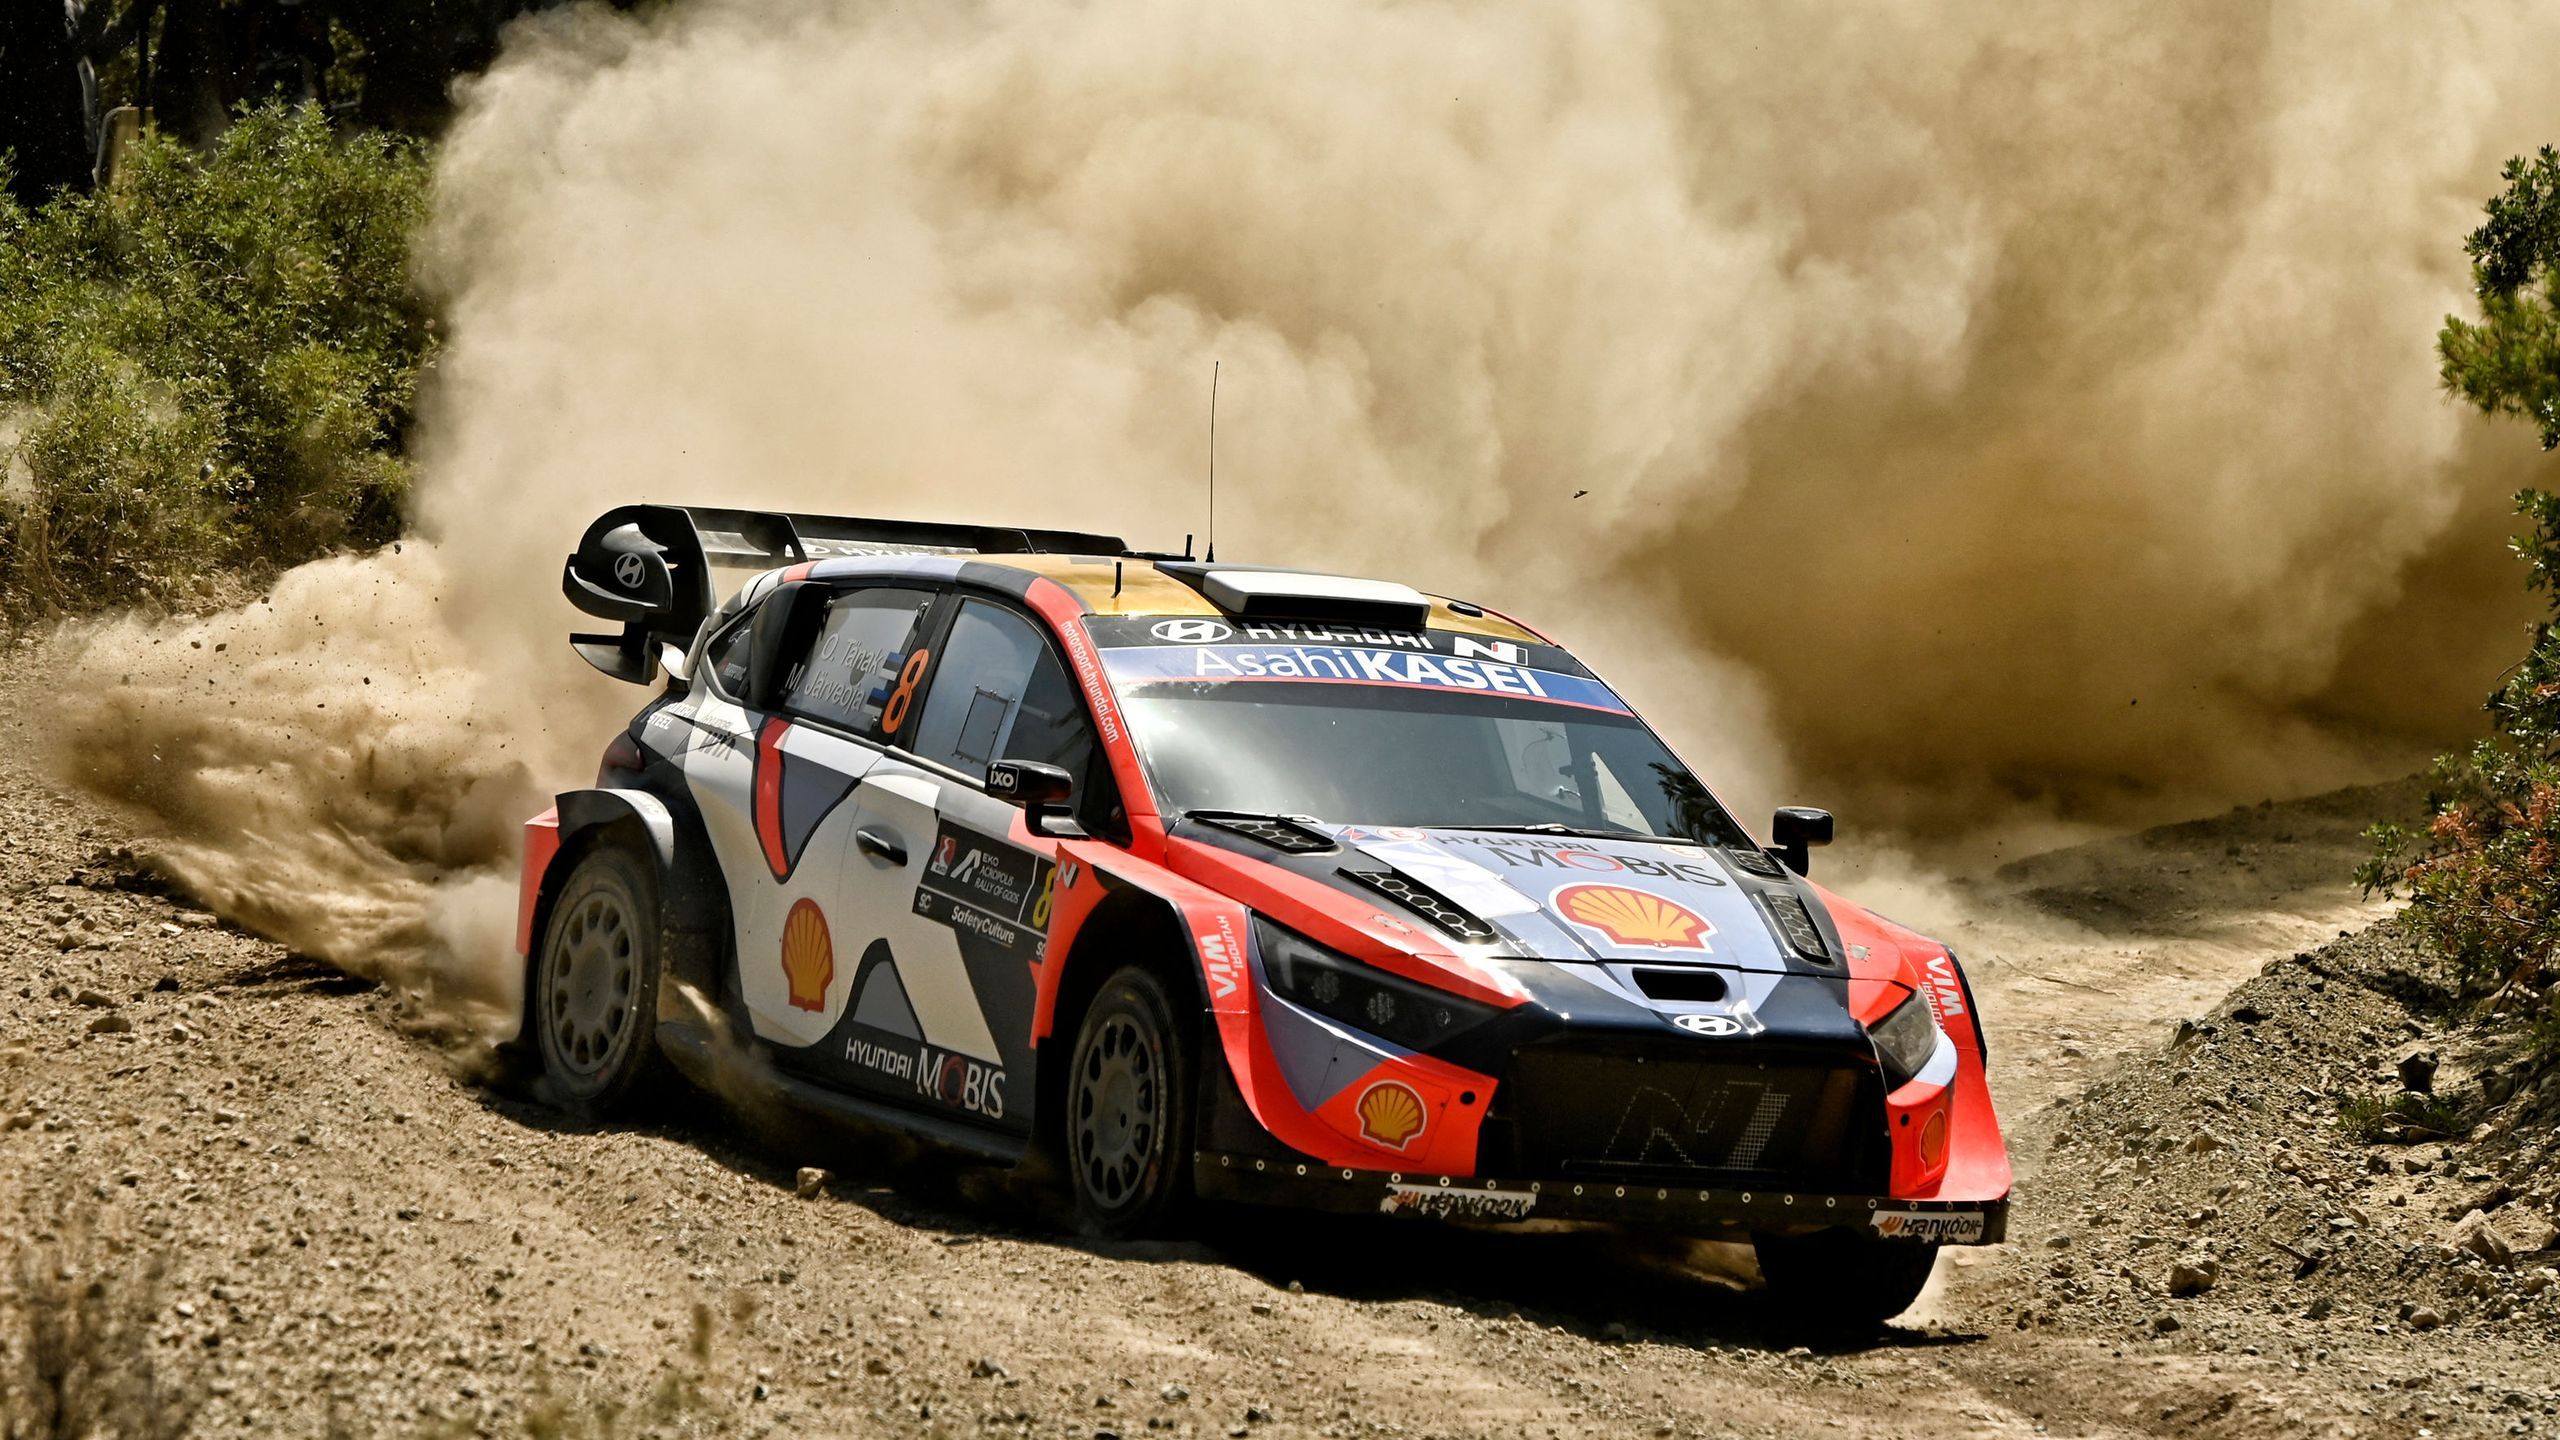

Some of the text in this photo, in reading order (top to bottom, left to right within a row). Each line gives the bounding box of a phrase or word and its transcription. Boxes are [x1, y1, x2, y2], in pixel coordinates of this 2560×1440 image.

[821, 633, 883, 675] O. Tänak
[1242, 623, 1434, 649] HYUNDAI
[785, 663, 806, 692] M.
[804, 670, 865, 716] Järveoja
[881, 648, 930, 734] 8
[1061, 621, 1120, 744] motorsport.hyundai.com
[1196, 648, 1548, 698] AsahiKASEI
[983, 853, 999, 867] EKO
[1433, 836, 1600, 852] HYUNDAI
[979, 865, 1015, 887] ACROPOLIS
[1056, 859, 1079, 889] N
[1484, 846, 1728, 887] MOBIS
[918, 892, 932, 910] SC
[975, 877, 1020, 904] RALLY OF GODS
[1032, 867, 1056, 928] 8
[951, 905, 1015, 945] SafetyCulture
[1216, 915, 1244, 969] HYUNDAI
[1200, 933, 1238, 999] WIA
[1926, 956, 1965, 1017] WIA
[845, 1037, 1006, 1119] HYUNDAI MOBIS
